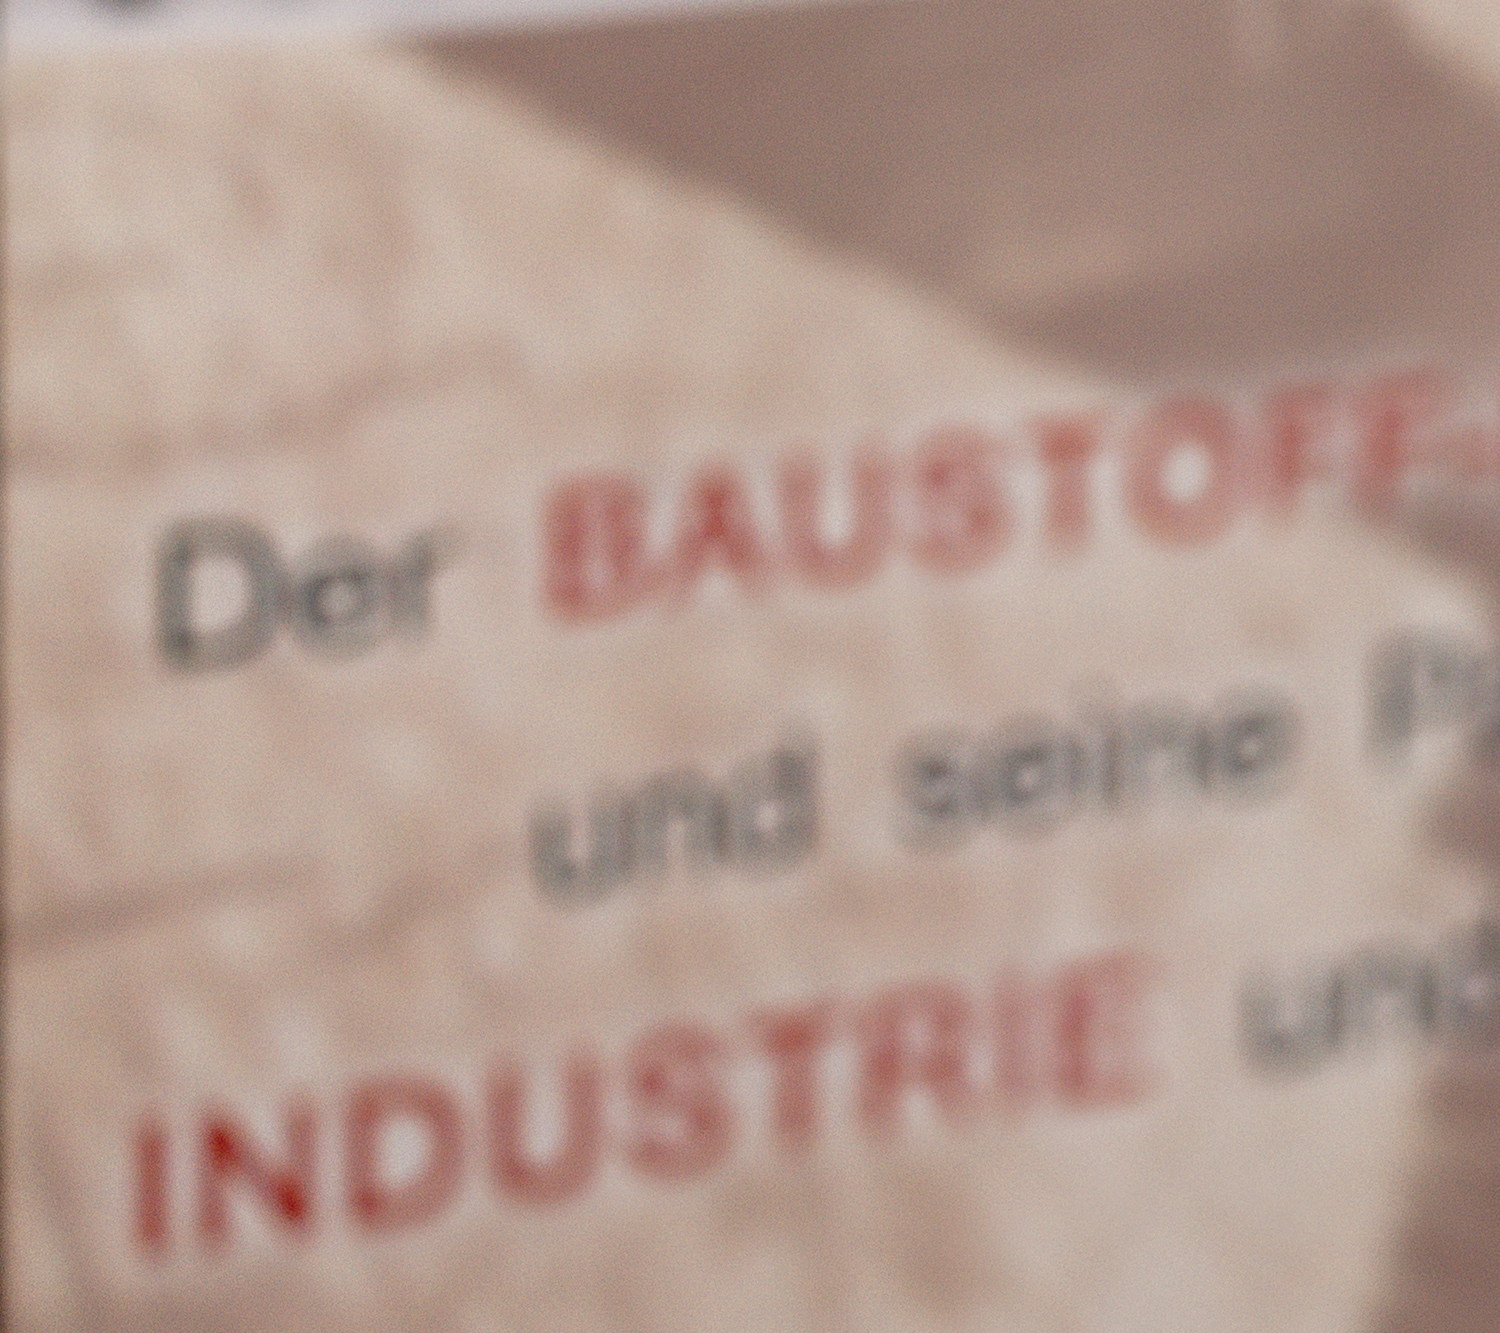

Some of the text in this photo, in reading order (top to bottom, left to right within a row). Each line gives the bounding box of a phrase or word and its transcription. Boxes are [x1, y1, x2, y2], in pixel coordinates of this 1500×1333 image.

[155, 516, 450, 673] Der
[532, 738, 822, 901] und
[900, 685, 1296, 845] seine
[132, 953, 1156, 1259] INDUSTRIE
